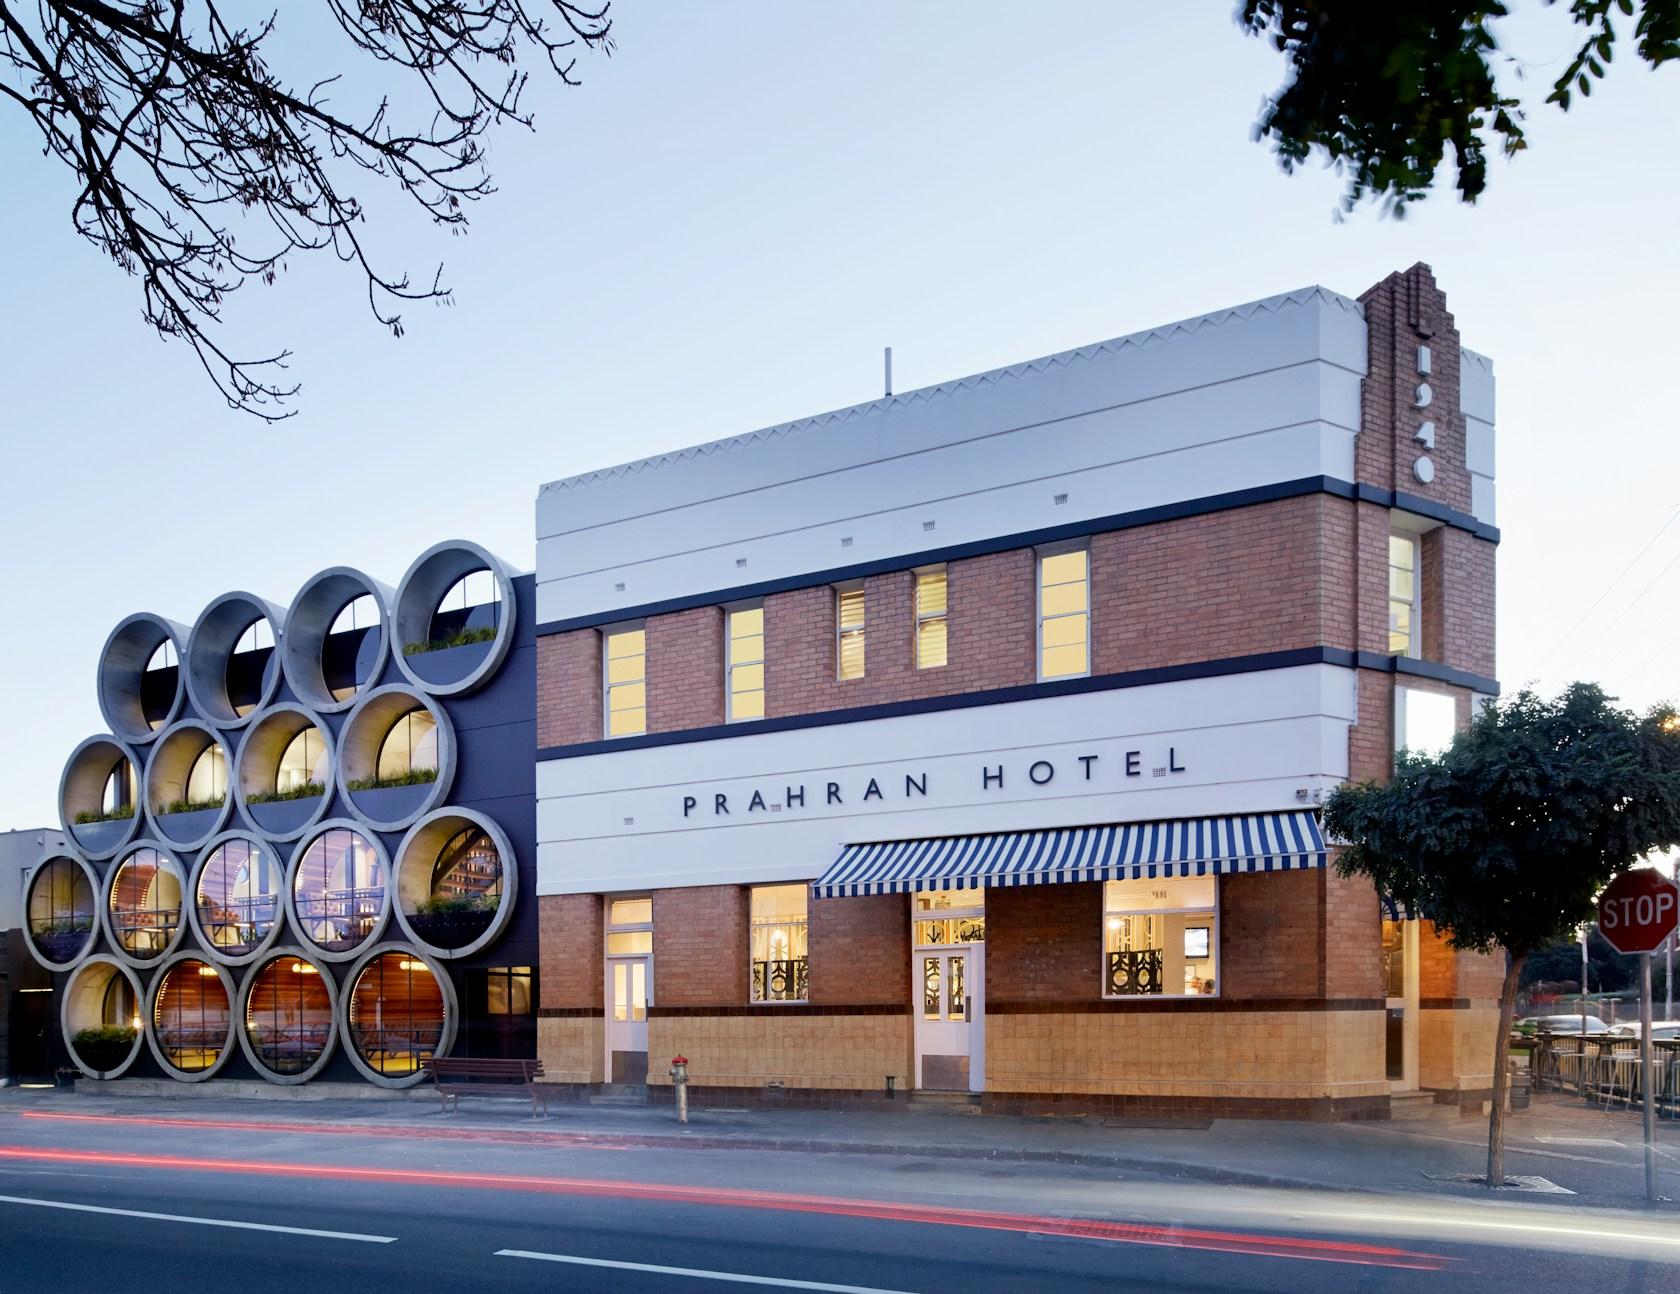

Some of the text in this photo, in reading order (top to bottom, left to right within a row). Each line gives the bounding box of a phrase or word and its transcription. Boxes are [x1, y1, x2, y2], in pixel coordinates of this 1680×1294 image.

[1413, 345, 1435, 484] 1940
[684, 747, 1186, 817] PRAHRAN HOTEL
[1603, 893, 1674, 928] STOP
